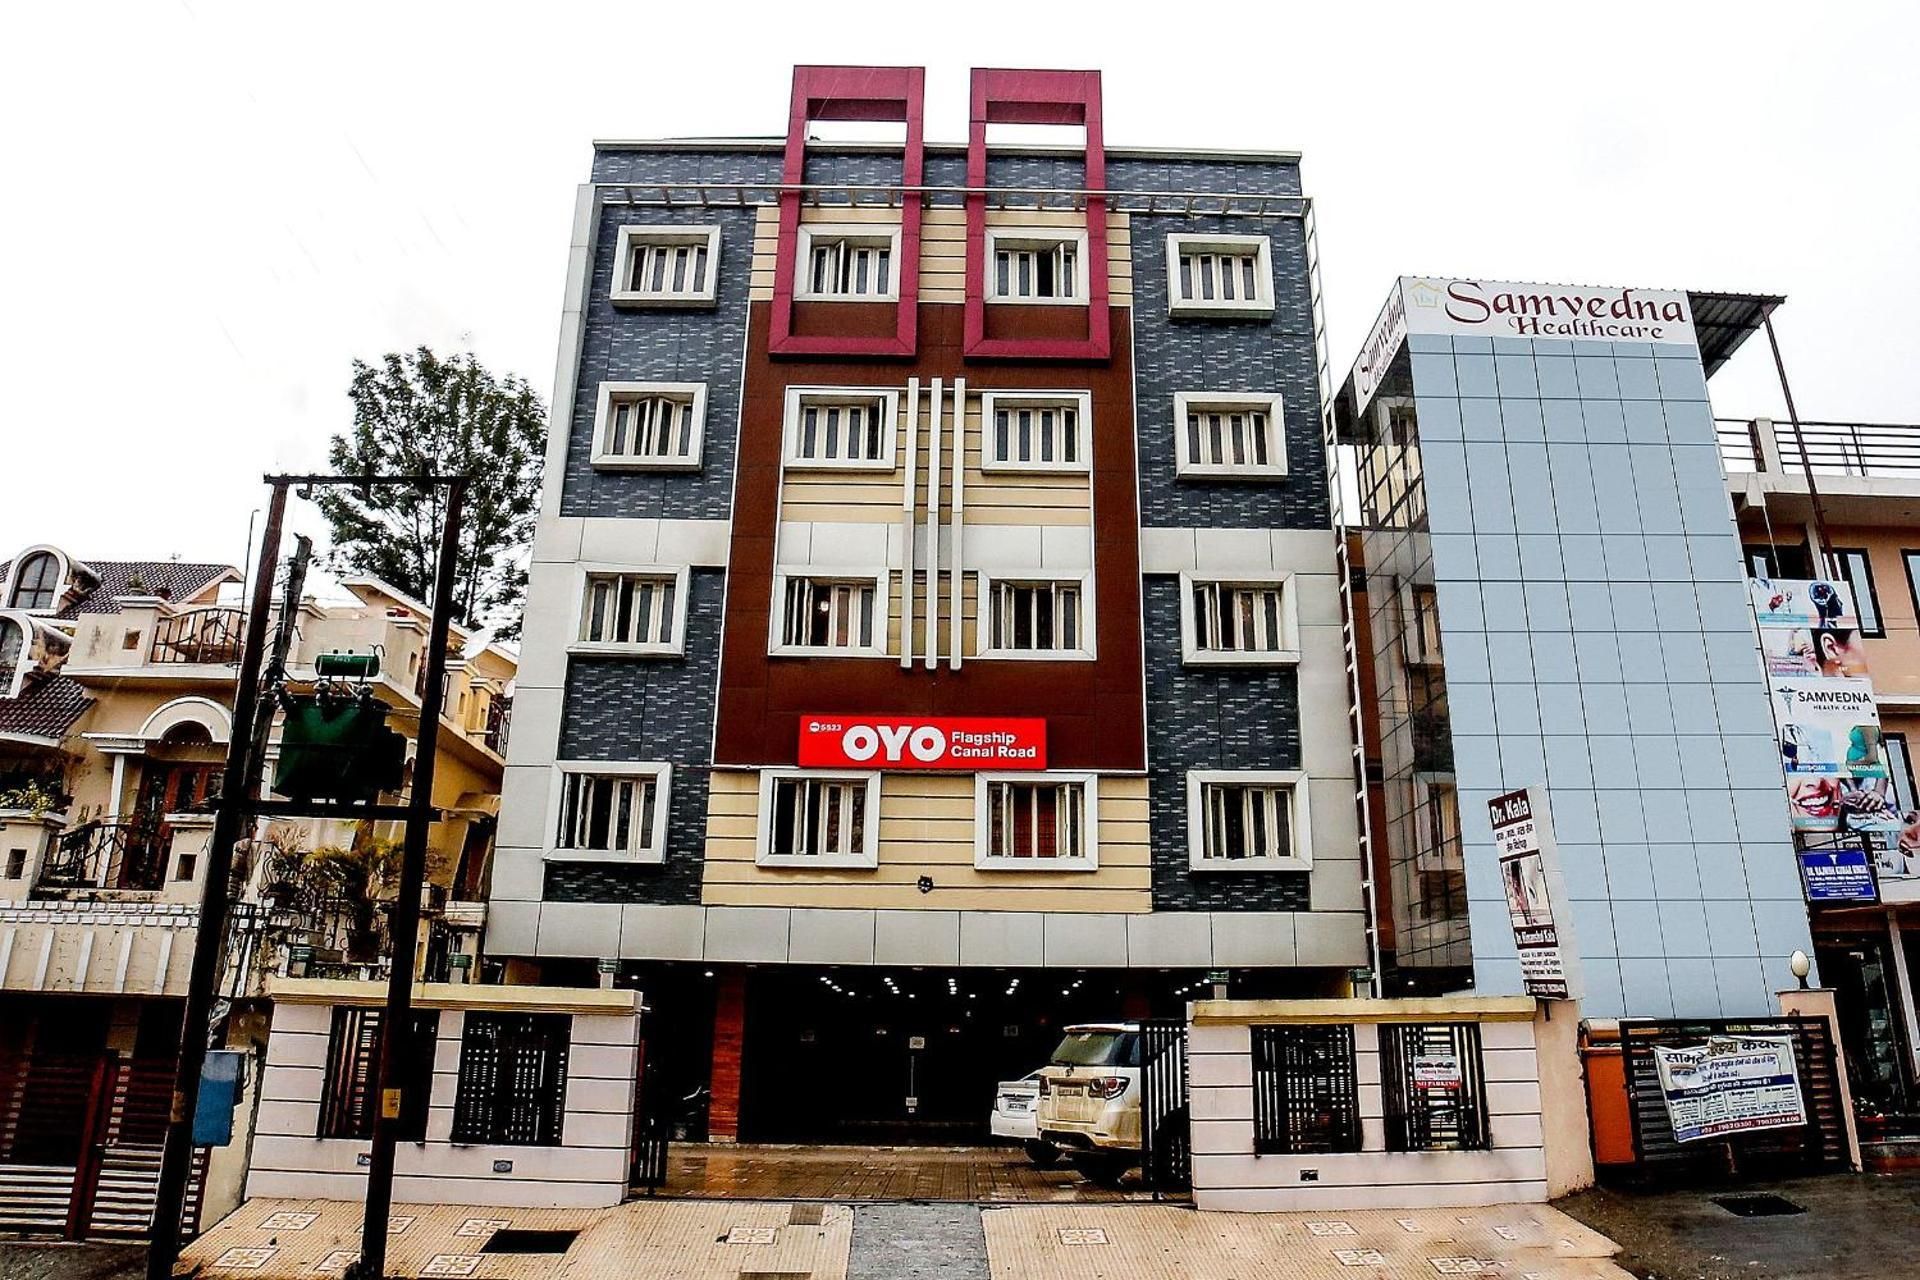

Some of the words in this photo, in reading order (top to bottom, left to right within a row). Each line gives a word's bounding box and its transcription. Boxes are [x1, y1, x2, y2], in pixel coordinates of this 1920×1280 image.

[1445, 281, 1687, 324] Samvedna
[1508, 317, 1665, 339] Healthcare
[1798, 691, 1872, 703] SAMVEDNA
[841, 725, 946, 762] OYO
[951, 731, 1017, 745] Flagship
[951, 745, 994, 757] Canal
[998, 745, 1036, 757] Road
[1491, 805, 1506, 825] Dr.
[1505, 797, 1530, 820] Kala
